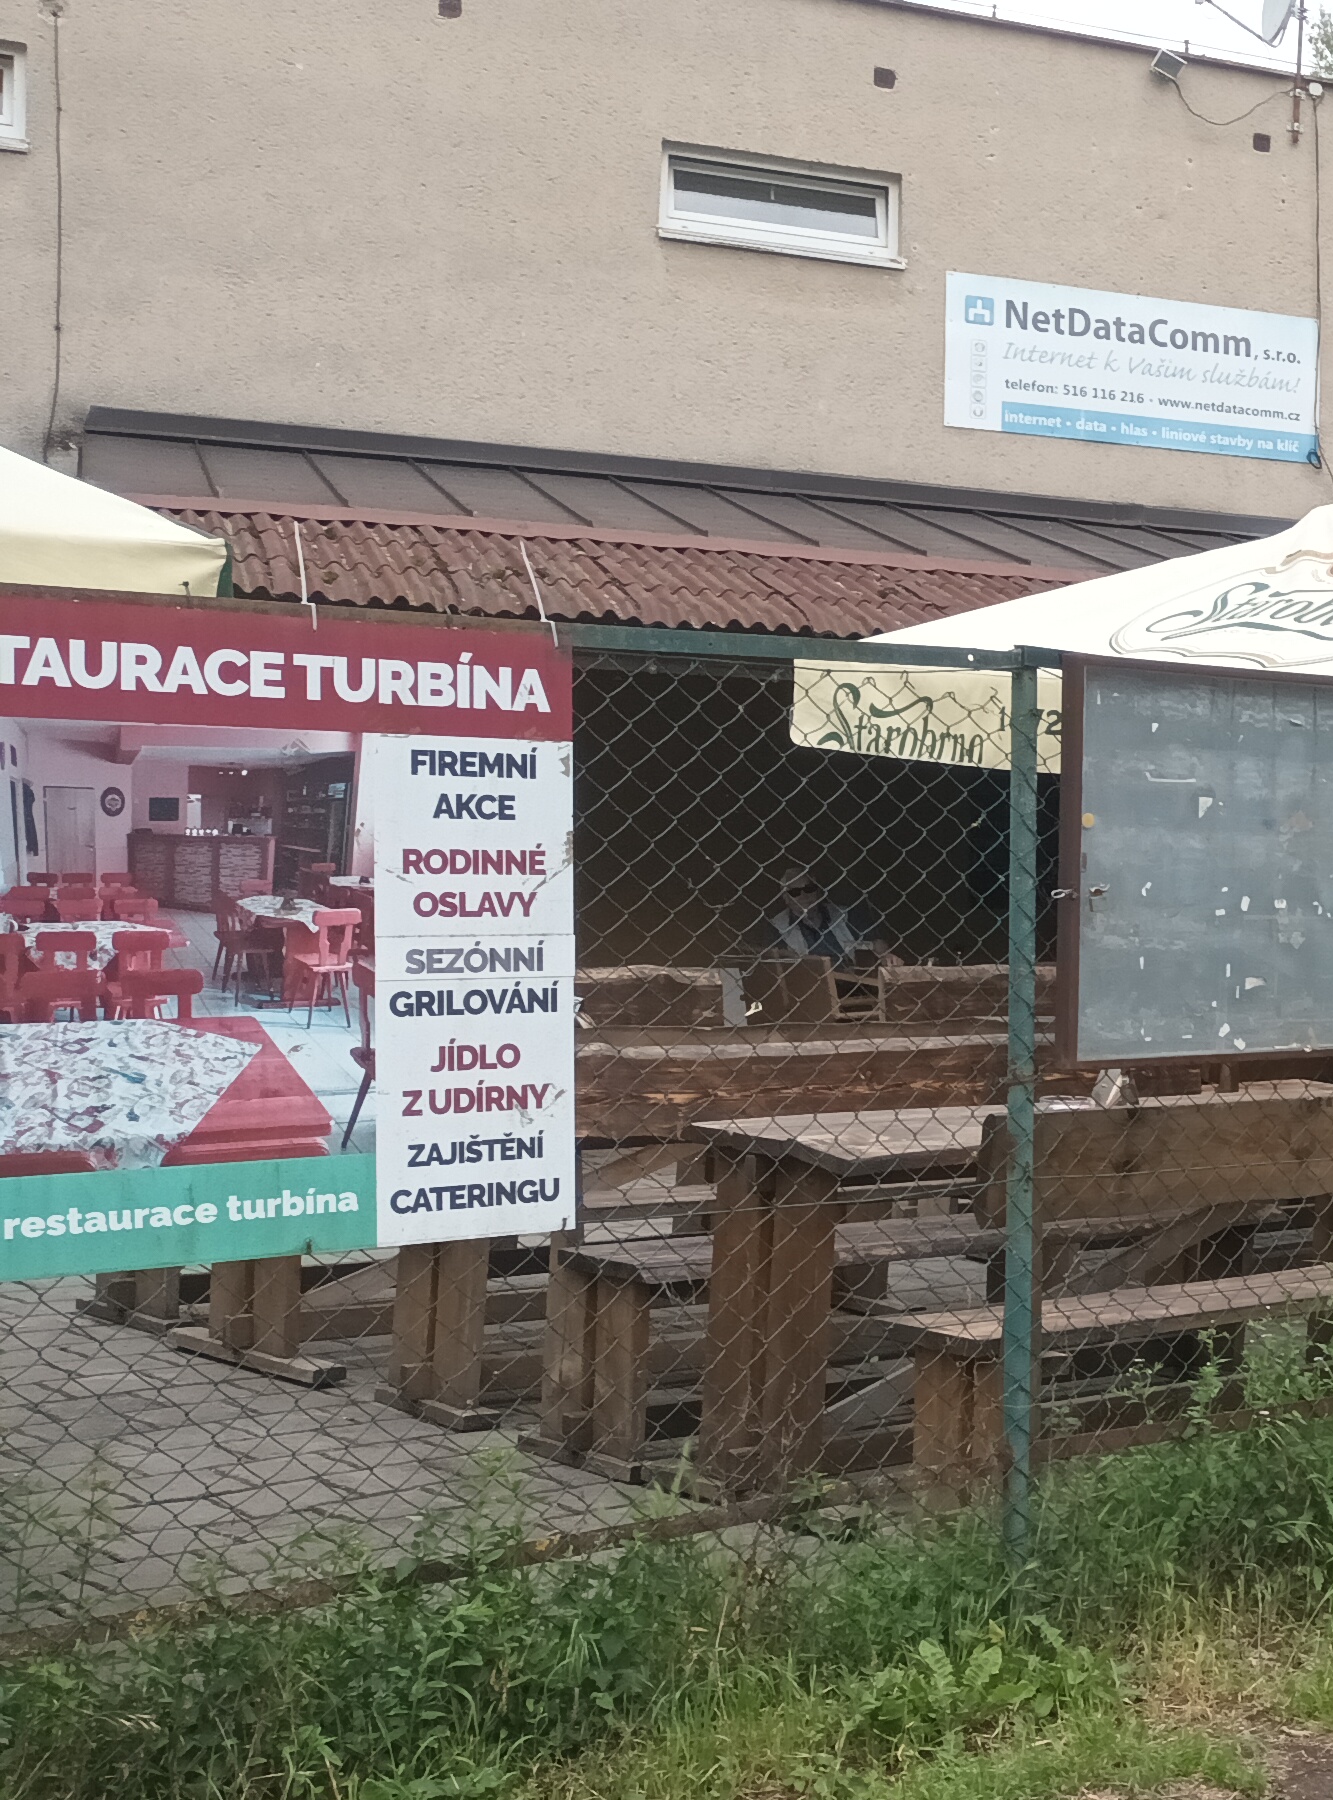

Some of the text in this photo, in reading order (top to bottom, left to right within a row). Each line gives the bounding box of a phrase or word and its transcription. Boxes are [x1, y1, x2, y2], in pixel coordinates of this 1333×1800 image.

[1005, 299, 1301, 364] NetDataComm, s.r.o.
[1002, 342, 1098, 369] Internet
[1104, 349, 1120, 372] k
[1201, 363, 1301, 393] službám!
[1004, 379, 1301, 421] telefon: 516 116 216 www.netdatacomm.cz
[1004, 409, 1299, 452] internet data hlas liniové stavby na klíč
[0, 634, 552, 713] TAURACE TURBÍNA
[817, 682, 1062, 765] Starobrno 172
[411, 747, 537, 779] FIREMNÍ
[433, 793, 516, 820] AKCE
[402, 843, 546, 875] RODINNÉ
[413, 891, 538, 917] OSLAVY
[405, 940, 544, 974] SEZÓNNÍ
[389, 980, 559, 1017] GRILOVÁNÍ
[430, 1038, 521, 1072] JÍDLO
[402, 1080, 551, 1116] Z UDÍRNY
[407, 1130, 544, 1167] ZAJIŠTĚNÍ
[4, 1187, 359, 1240] restaurace turbína
[390, 1178, 560, 1214] CATERINGU
